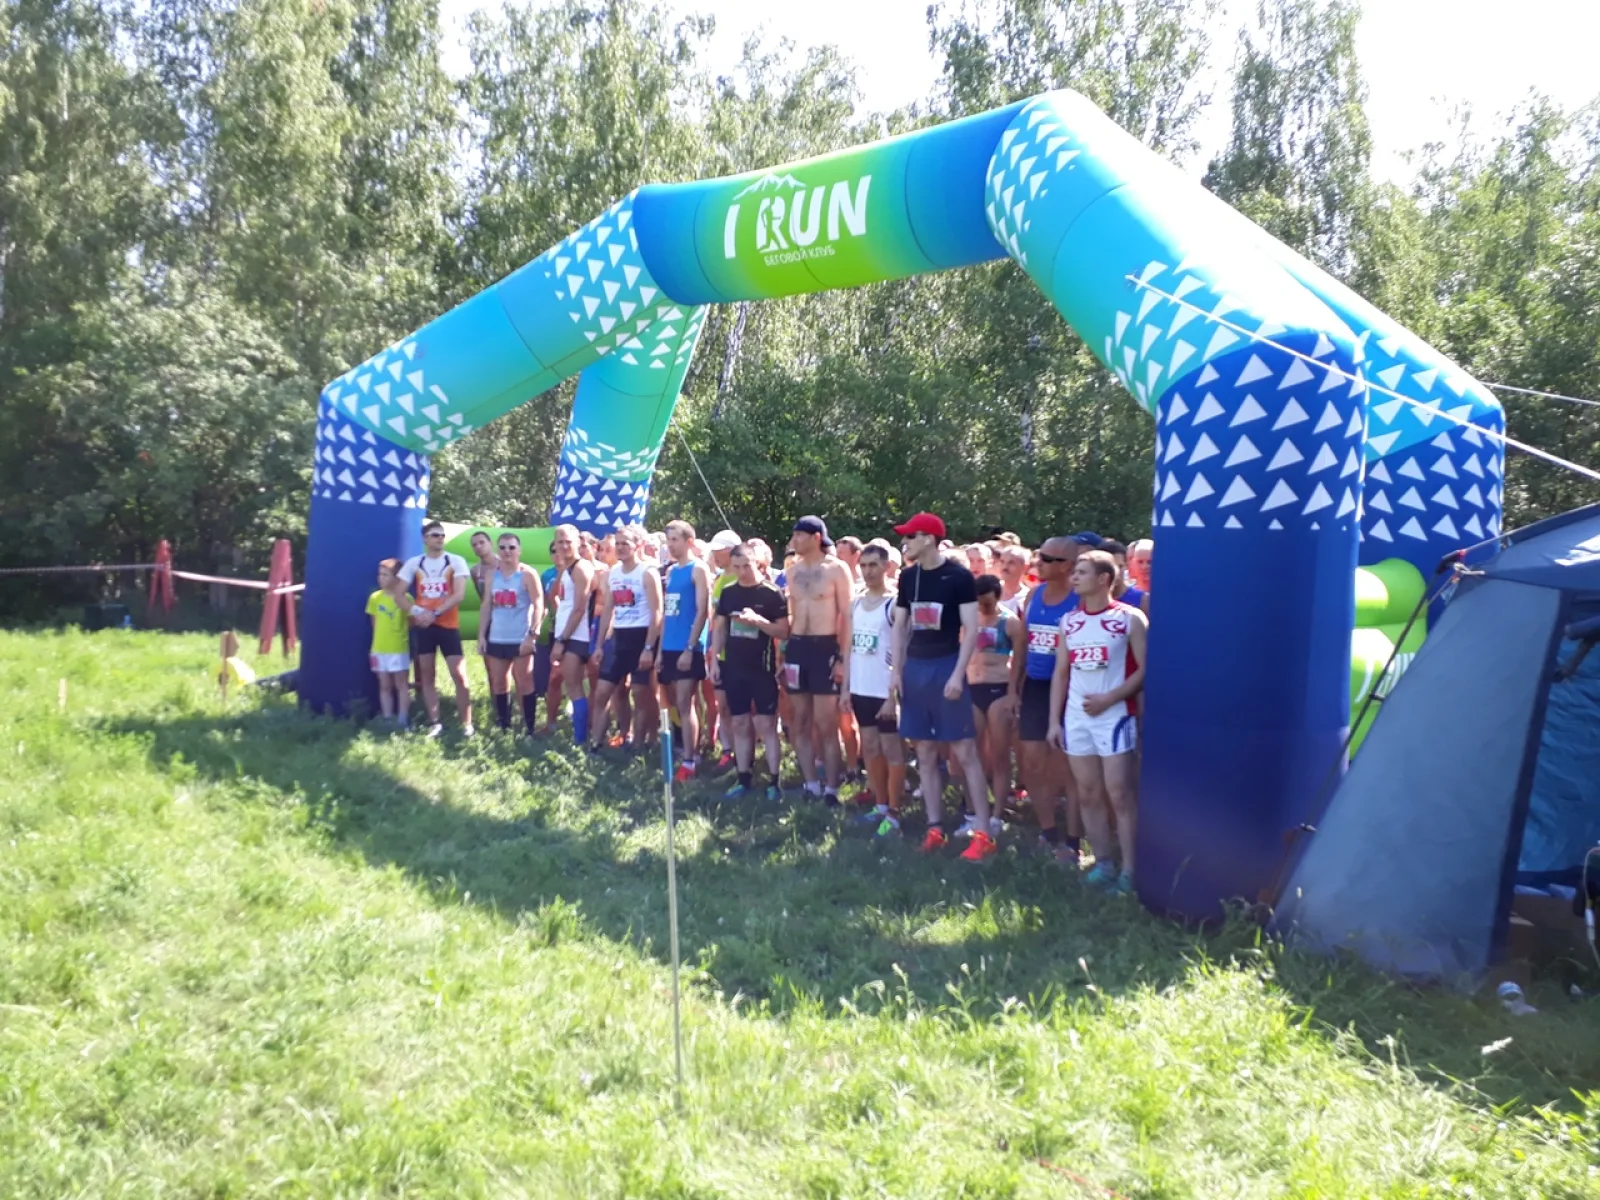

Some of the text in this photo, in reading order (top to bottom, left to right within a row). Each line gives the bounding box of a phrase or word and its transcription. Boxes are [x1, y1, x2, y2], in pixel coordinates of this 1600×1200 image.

[724, 175, 872, 259] I RUN
[1031, 632, 1056, 646] 205
[1074, 648, 1103, 662] 228
